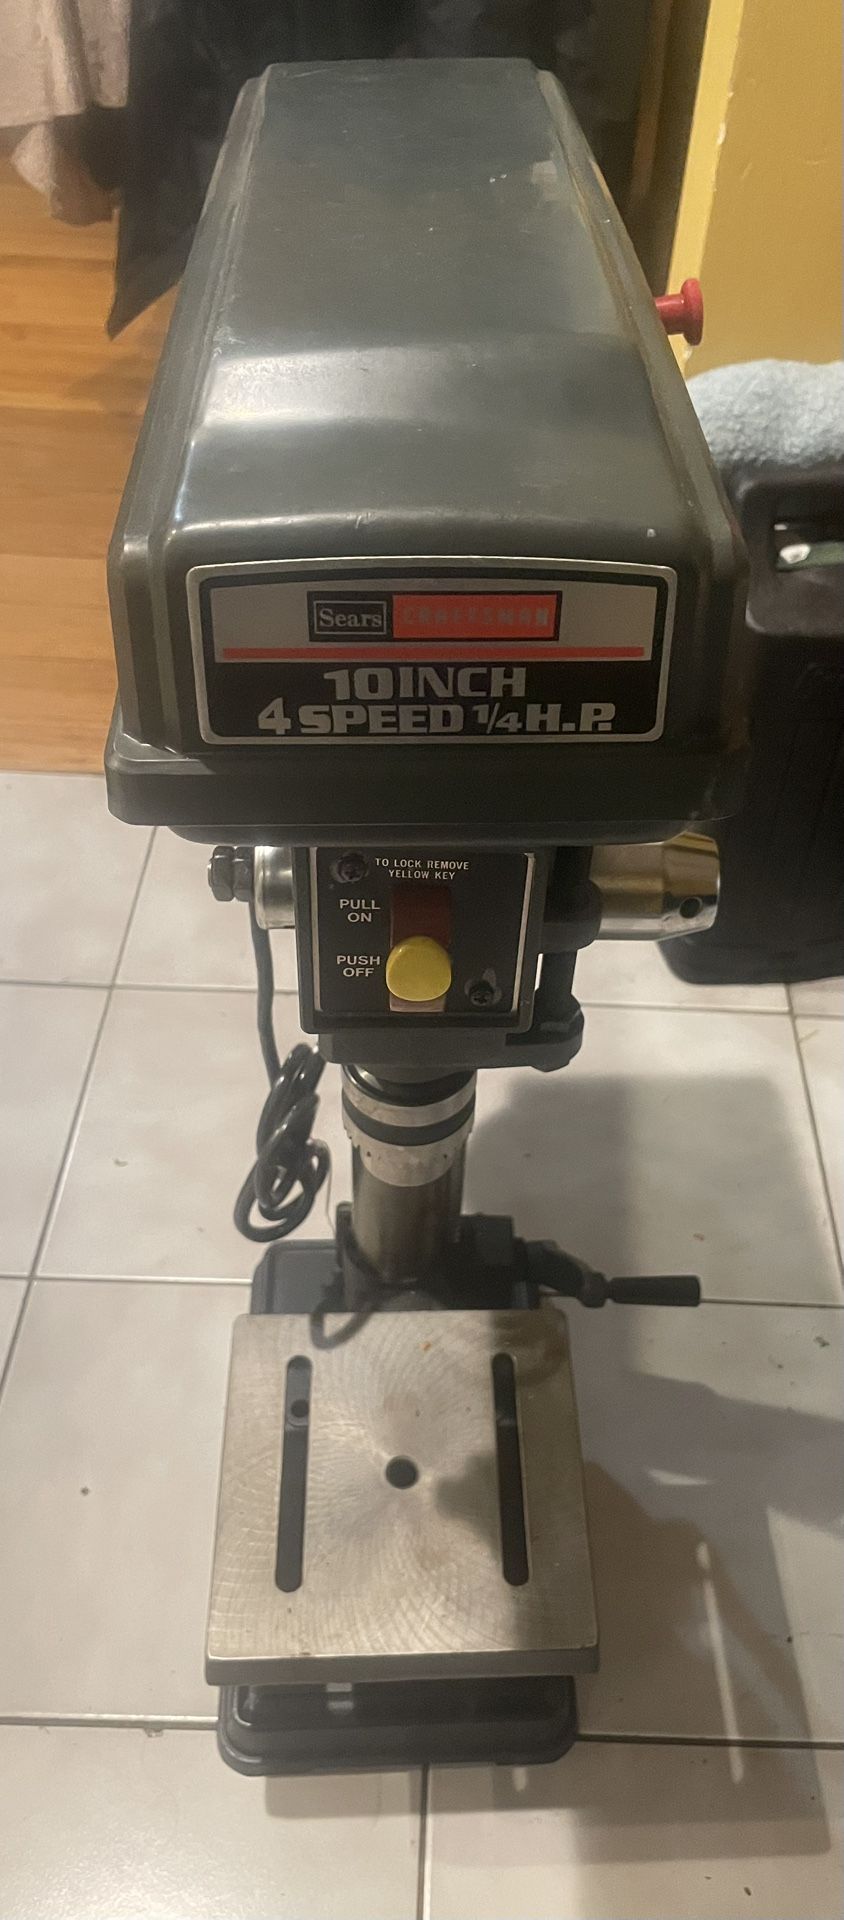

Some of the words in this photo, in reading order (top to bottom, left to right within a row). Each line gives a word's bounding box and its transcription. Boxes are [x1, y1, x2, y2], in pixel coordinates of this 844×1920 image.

[319, 608, 382, 628] Sears
[258, 698, 291, 735] 4
[300, 705, 464, 734] SPEED
[376, 858, 388, 868] TO
[394, 859, 421, 868] LOCK
[428, 861, 469, 870] REMOVE
[389, 870, 430, 879] YELLOW
[435, 871, 456, 880] KEY
[340, 899, 380, 909] PULL
[348, 913, 372, 922] ON
[337, 955, 380, 965] PUSH
[343, 968, 374, 977] OFF
